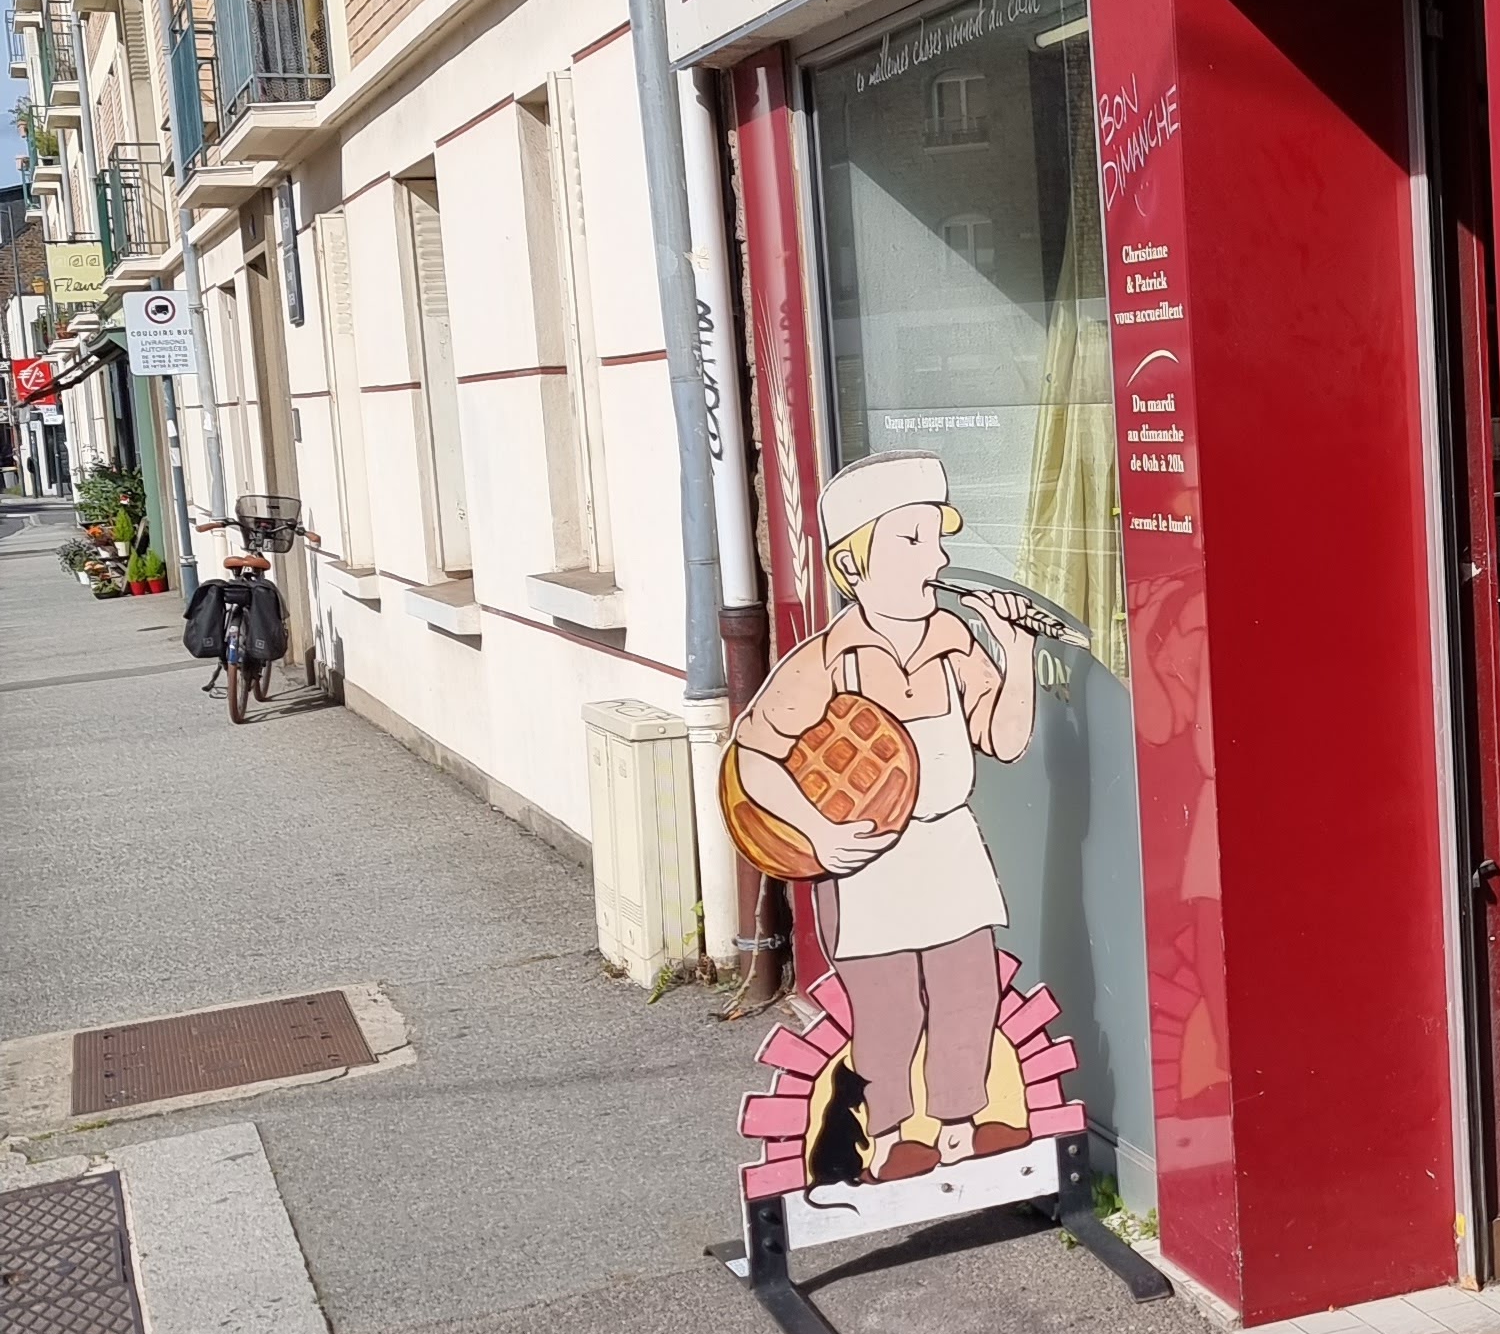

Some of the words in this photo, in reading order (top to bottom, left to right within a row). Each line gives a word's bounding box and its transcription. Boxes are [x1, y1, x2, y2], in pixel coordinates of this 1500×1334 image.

[1099, 73, 1138, 146] BON
[1122, 242, 1168, 263] Christiane
[1126, 275, 1134, 294] &
[1135, 270, 1168, 292] Patrick
[1114, 311, 1135, 325] vous
[1135, 301, 1184, 323] accueillent
[1131, 394, 1147, 413] Du
[1147, 393, 1176, 412] mardi
[1127, 430, 1140, 442] au
[1140, 424, 1184, 442] dimanche
[1130, 454, 1141, 472] de
[1160, 454, 1167, 472] à
[1167, 454, 1185, 472] 20h
[1158, 513, 1167, 531] le
[1168, 514, 1193, 534] lundi
